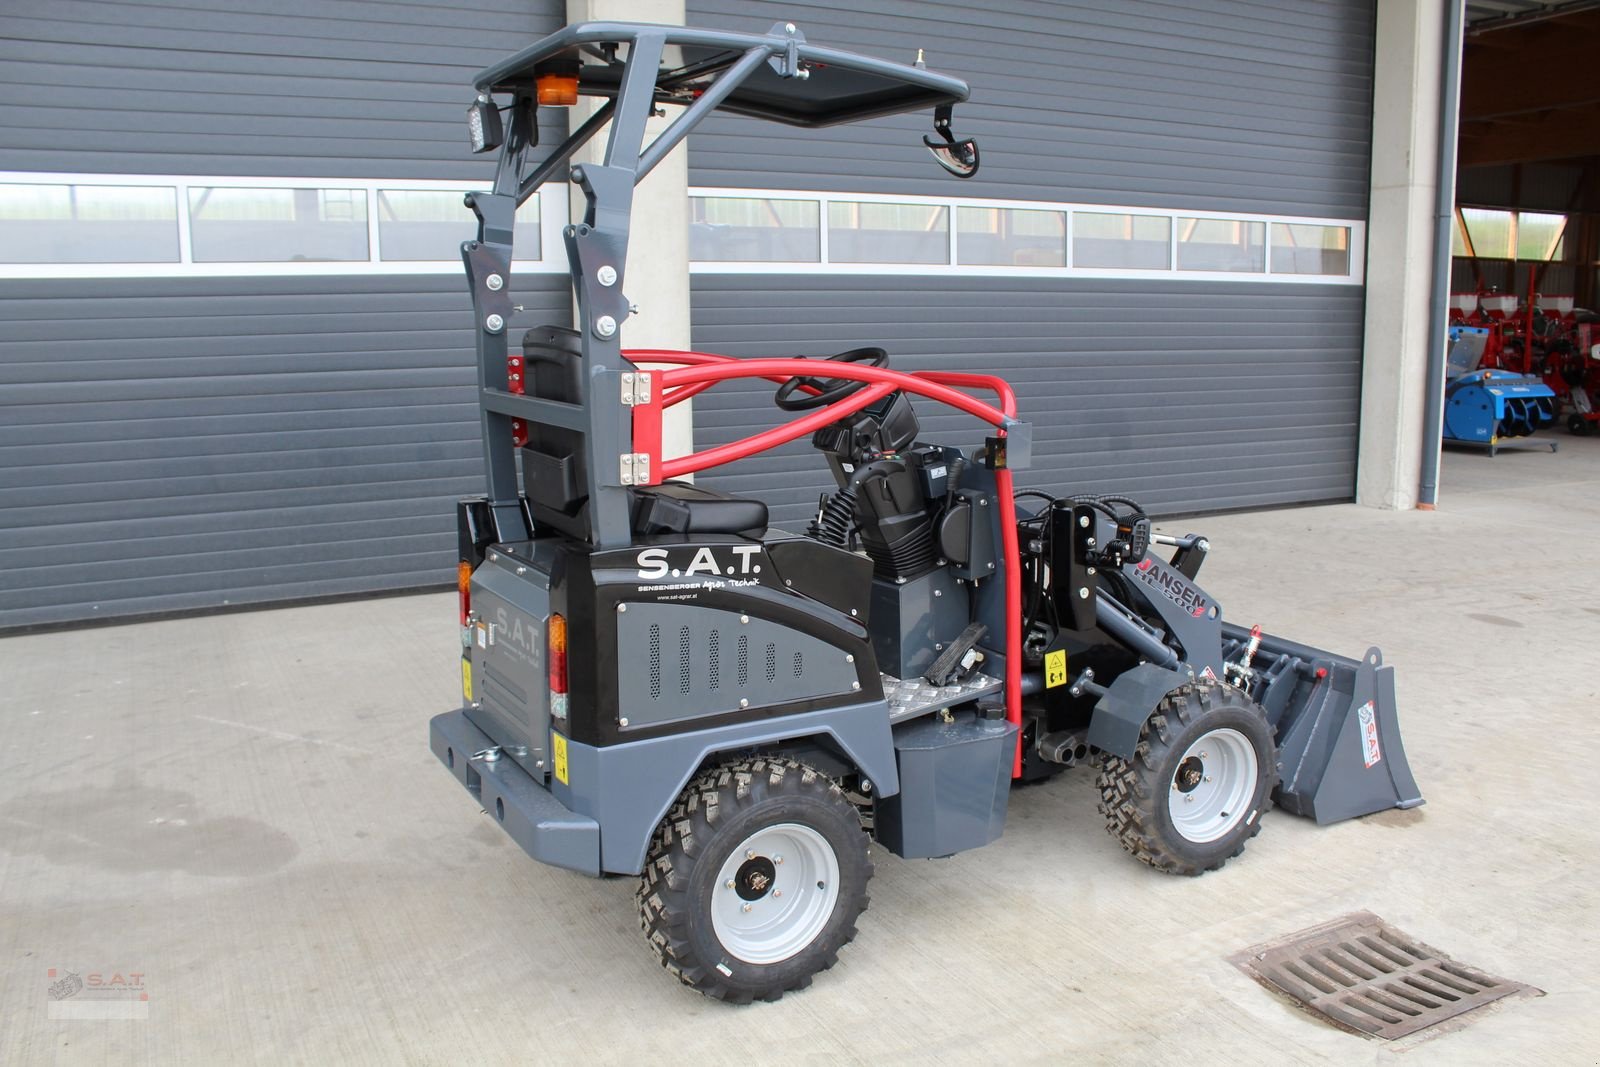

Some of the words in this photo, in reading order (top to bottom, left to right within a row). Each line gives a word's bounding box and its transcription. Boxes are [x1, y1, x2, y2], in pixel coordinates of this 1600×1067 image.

[637, 545, 762, 580] S.A.T.
[1137, 558, 1207, 608] JANSEN
[638, 583, 701, 592] SENSENBERGER
[497, 607, 540, 657] S.A.T.
